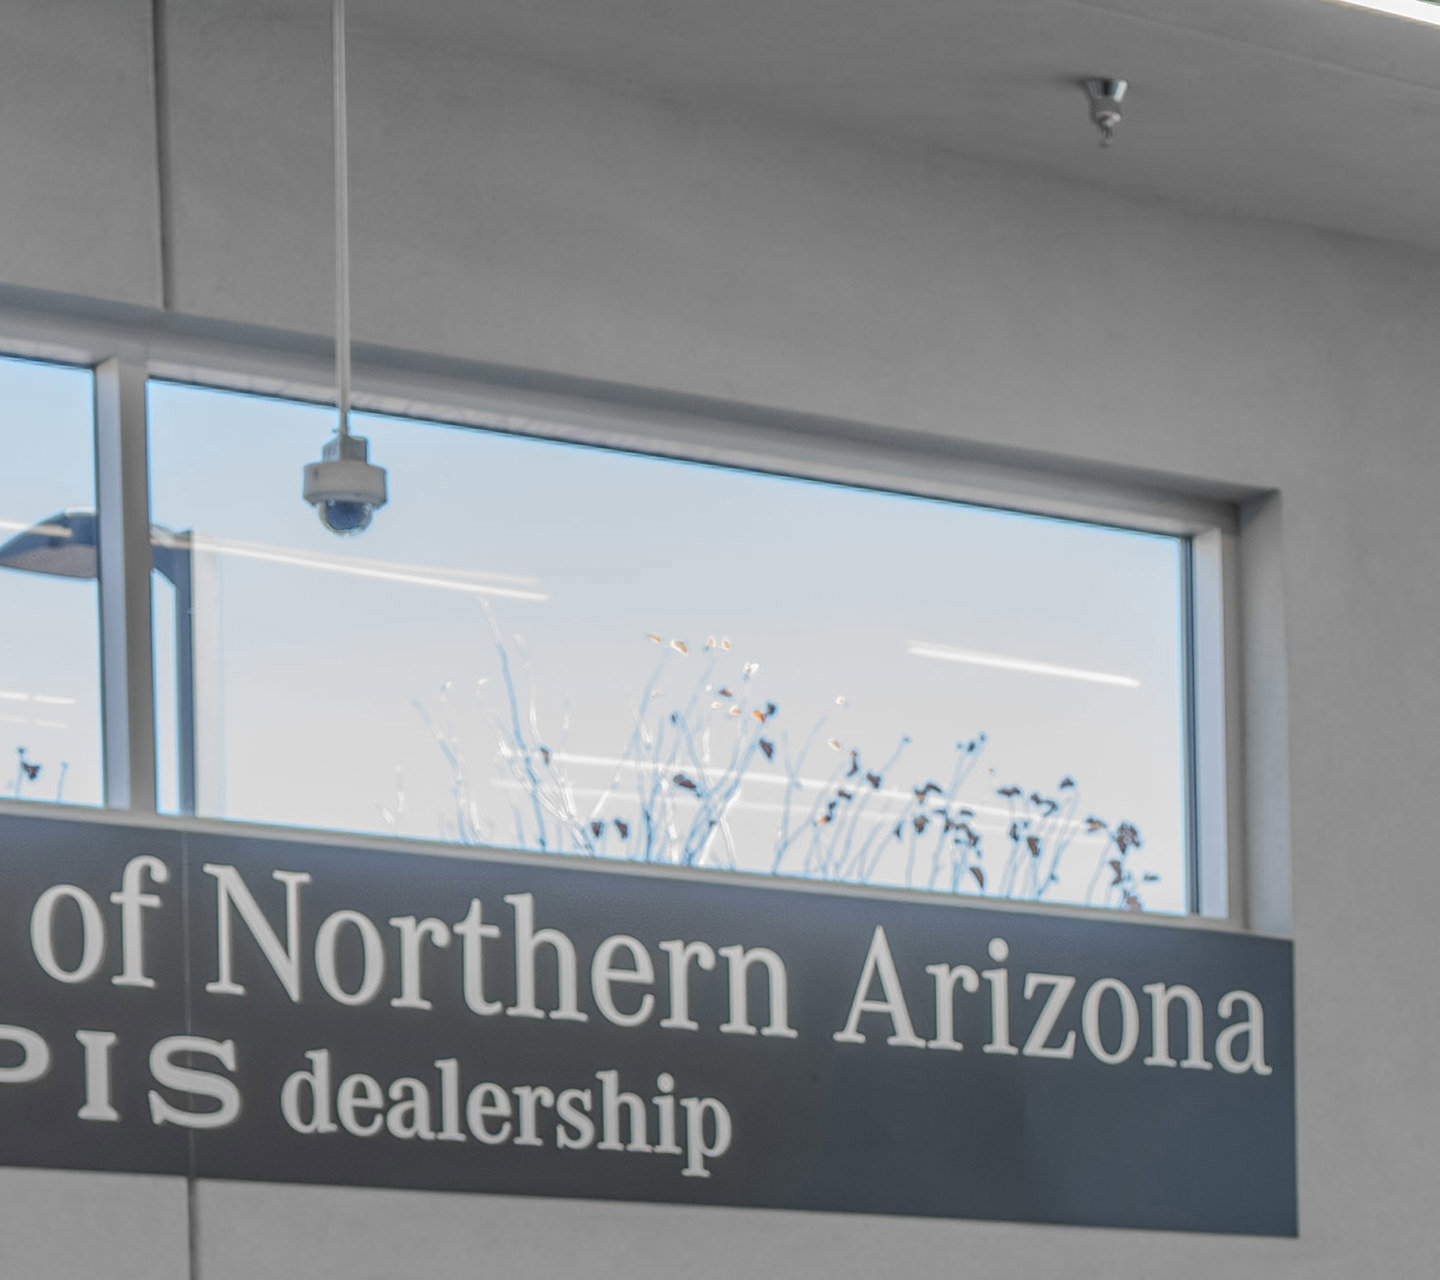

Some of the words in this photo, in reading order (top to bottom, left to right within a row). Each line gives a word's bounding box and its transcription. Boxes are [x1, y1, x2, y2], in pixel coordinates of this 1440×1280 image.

[30, 853, 169, 989] of
[202, 860, 799, 1040] Northern
[835, 922, 1271, 1077] Arizona
[279, 1047, 733, 1179] dealership
